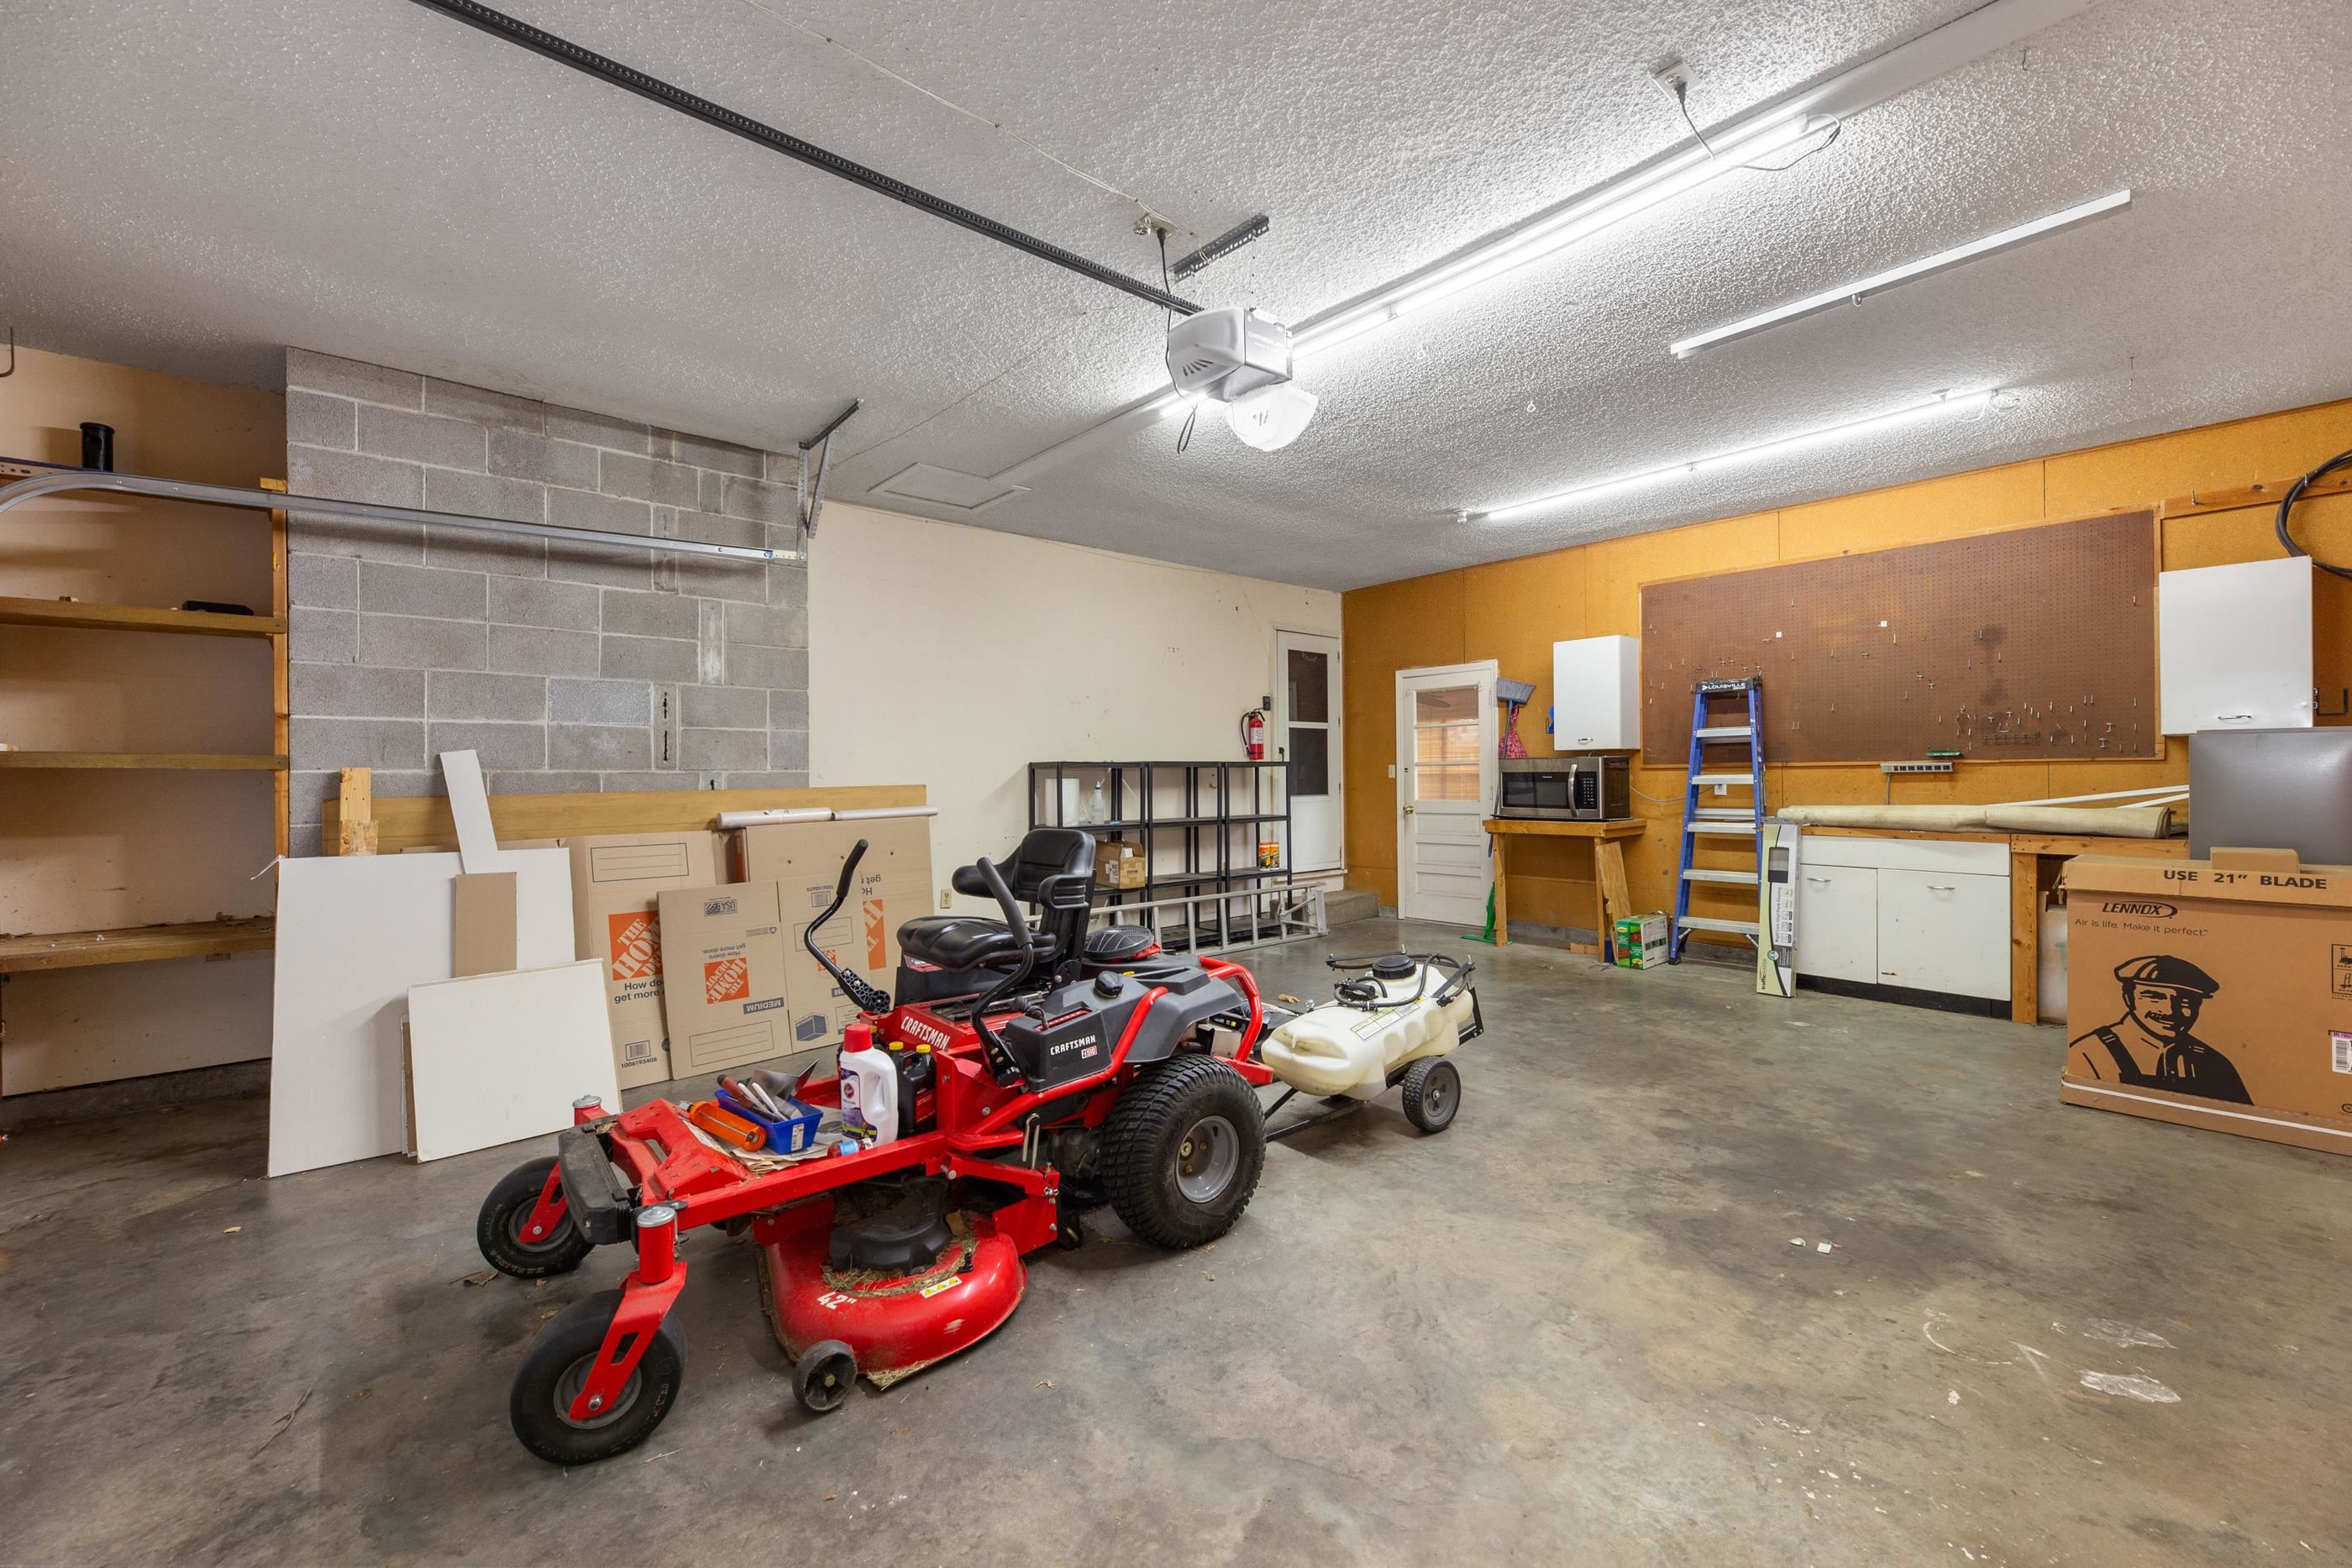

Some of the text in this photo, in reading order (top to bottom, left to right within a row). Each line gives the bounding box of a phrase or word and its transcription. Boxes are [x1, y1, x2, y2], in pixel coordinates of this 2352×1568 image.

[866, 874, 881, 885] get
[2163, 870, 2327, 889] USE 21" BLADE
[721, 900, 736, 910] USA
[2102, 902, 2163, 915] LENNOX
[617, 918, 647, 947] THE
[2075, 918, 2088, 926] Air
[2092, 920, 2099, 928] is
[2103, 920, 2118, 929] life.
[2124, 922, 2150, 932] Make
[2153, 924, 2161, 933] it
[719, 945, 735, 954] more
[736, 942, 746, 952] get
[708, 952, 727, 960] doers
[706, 959, 731, 989] DEPOT
[706, 958, 748, 1003] HOME
[624, 978, 647, 991] How
[727, 977, 746, 997] THE
[614, 989, 659, 1004] get more
[746, 998, 781, 1013] MEDIUM
[900, 1015, 951, 1051] CRAFTSMAN
[1050, 1034, 1096, 1056] CRAFTSMAN
